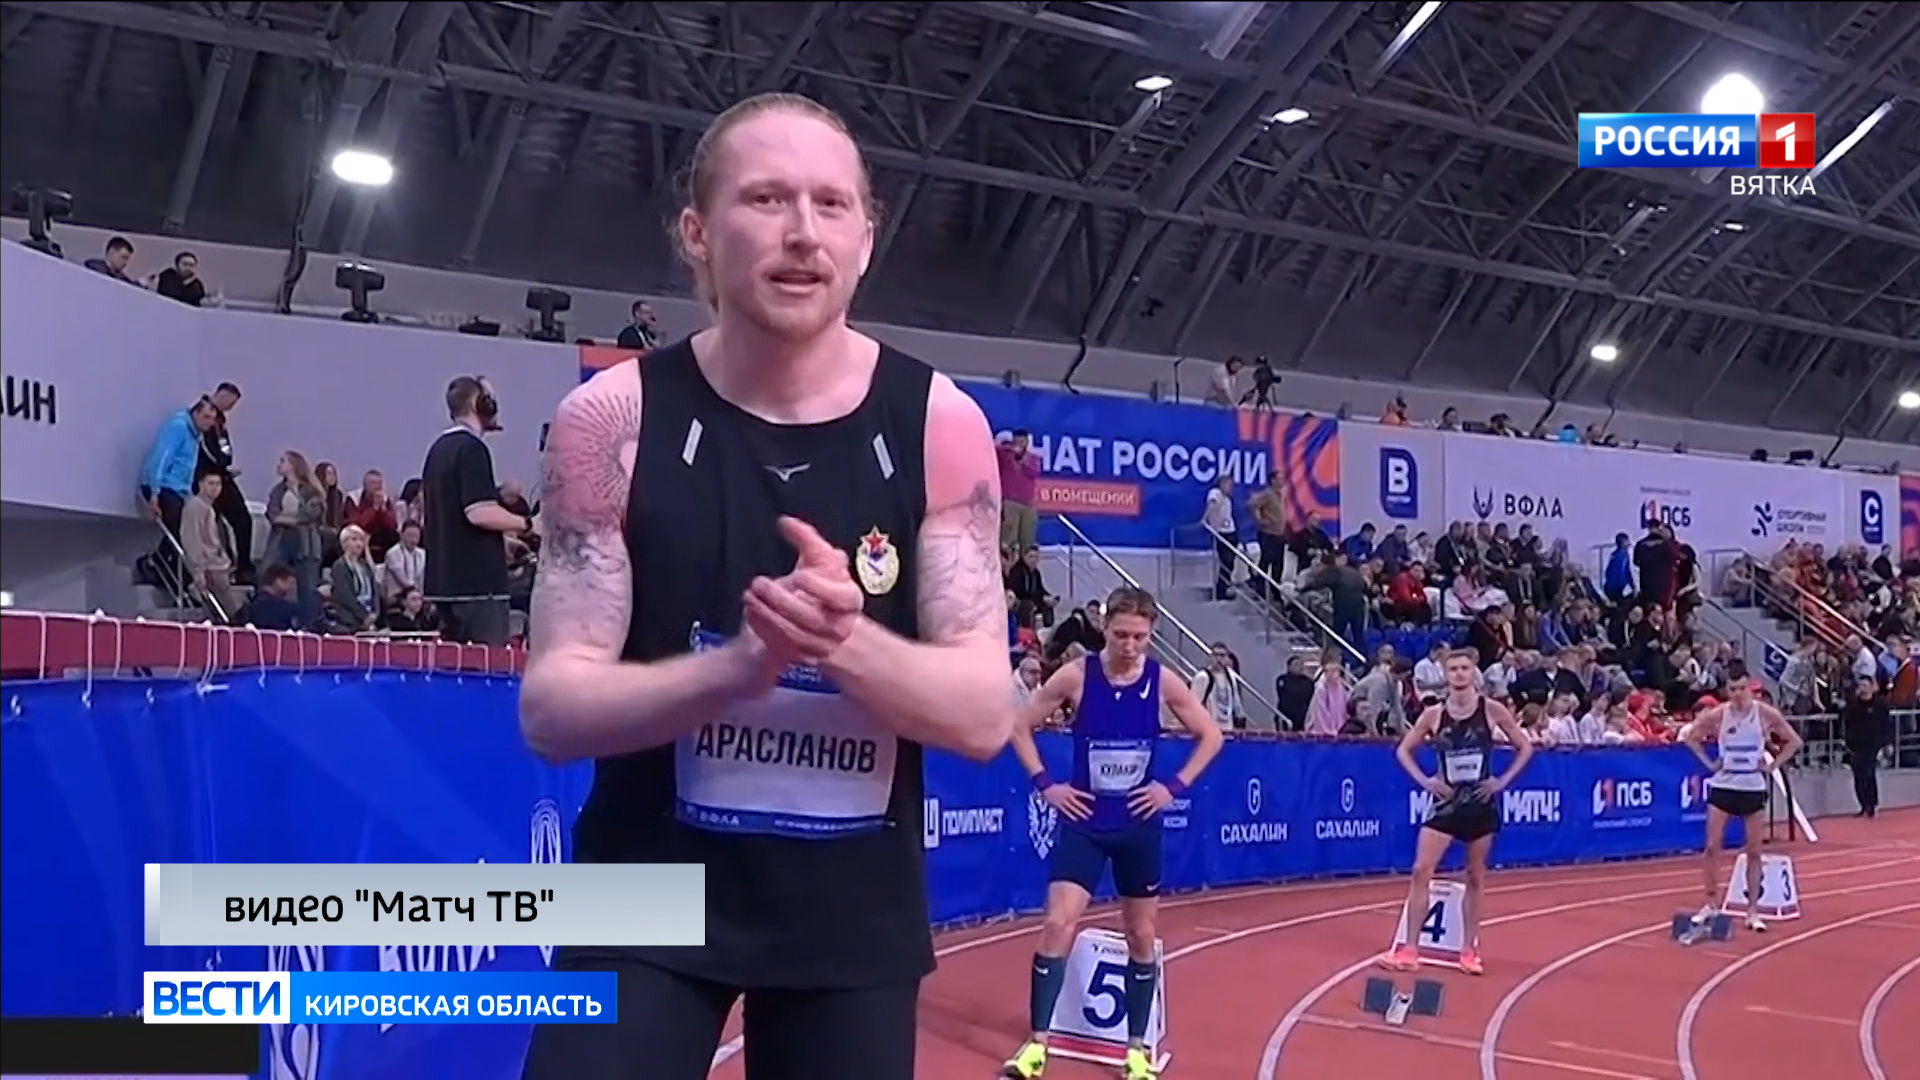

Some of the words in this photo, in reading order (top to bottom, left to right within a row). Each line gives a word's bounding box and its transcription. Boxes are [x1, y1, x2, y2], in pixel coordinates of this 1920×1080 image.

[994, 429, 1102, 475] НАТ
[1112, 440, 1266, 485] РОССИИ
[1052, 488, 1134, 505] ПОМЕЩЕНИИ
[1504, 493, 1563, 518] ВФЛА
[1660, 504, 1690, 526] ПСБ
[695, 722, 877, 773] АРАСЛАНОВ
[1503, 789, 1560, 824] МАТЧ!
[1616, 781, 1652, 807] ПСБ
[942, 807, 1004, 836] ПОЛИПЛАСТ
[1220, 822, 1288, 845] САХАЛИН
[1315, 818, 1380, 840] САХАЛИН
[1420, 900, 1446, 943] 4
[1083, 961, 1129, 1029] 5
